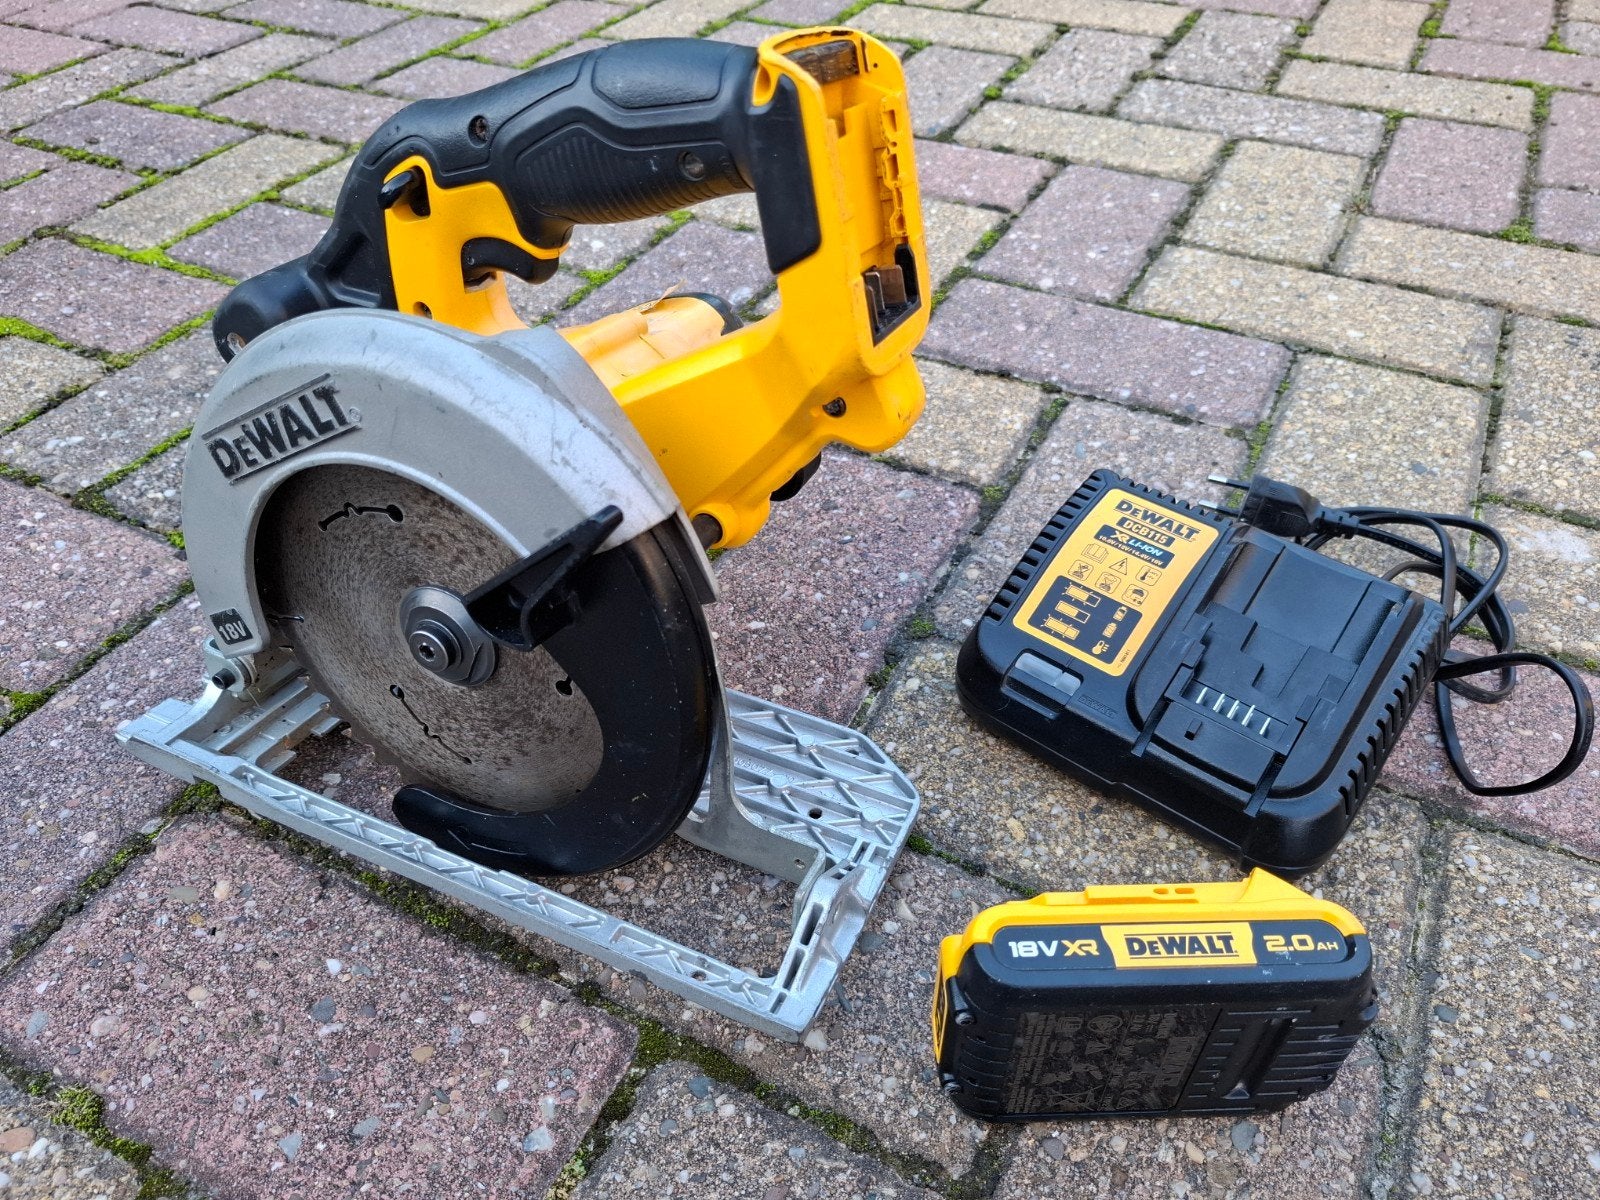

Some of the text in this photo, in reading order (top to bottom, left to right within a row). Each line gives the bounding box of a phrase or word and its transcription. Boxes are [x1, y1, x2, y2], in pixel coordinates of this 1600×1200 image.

[1115, 500, 1200, 540] DEWALT
[1123, 520, 1168, 544] DCB115
[1128, 539, 1163, 557] LI-ION
[218, 620, 246, 640] 18V
[1008, 941, 1058, 958] 18V
[1061, 940, 1100, 956] XR
[1125, 934, 1235, 956] DEWALT
